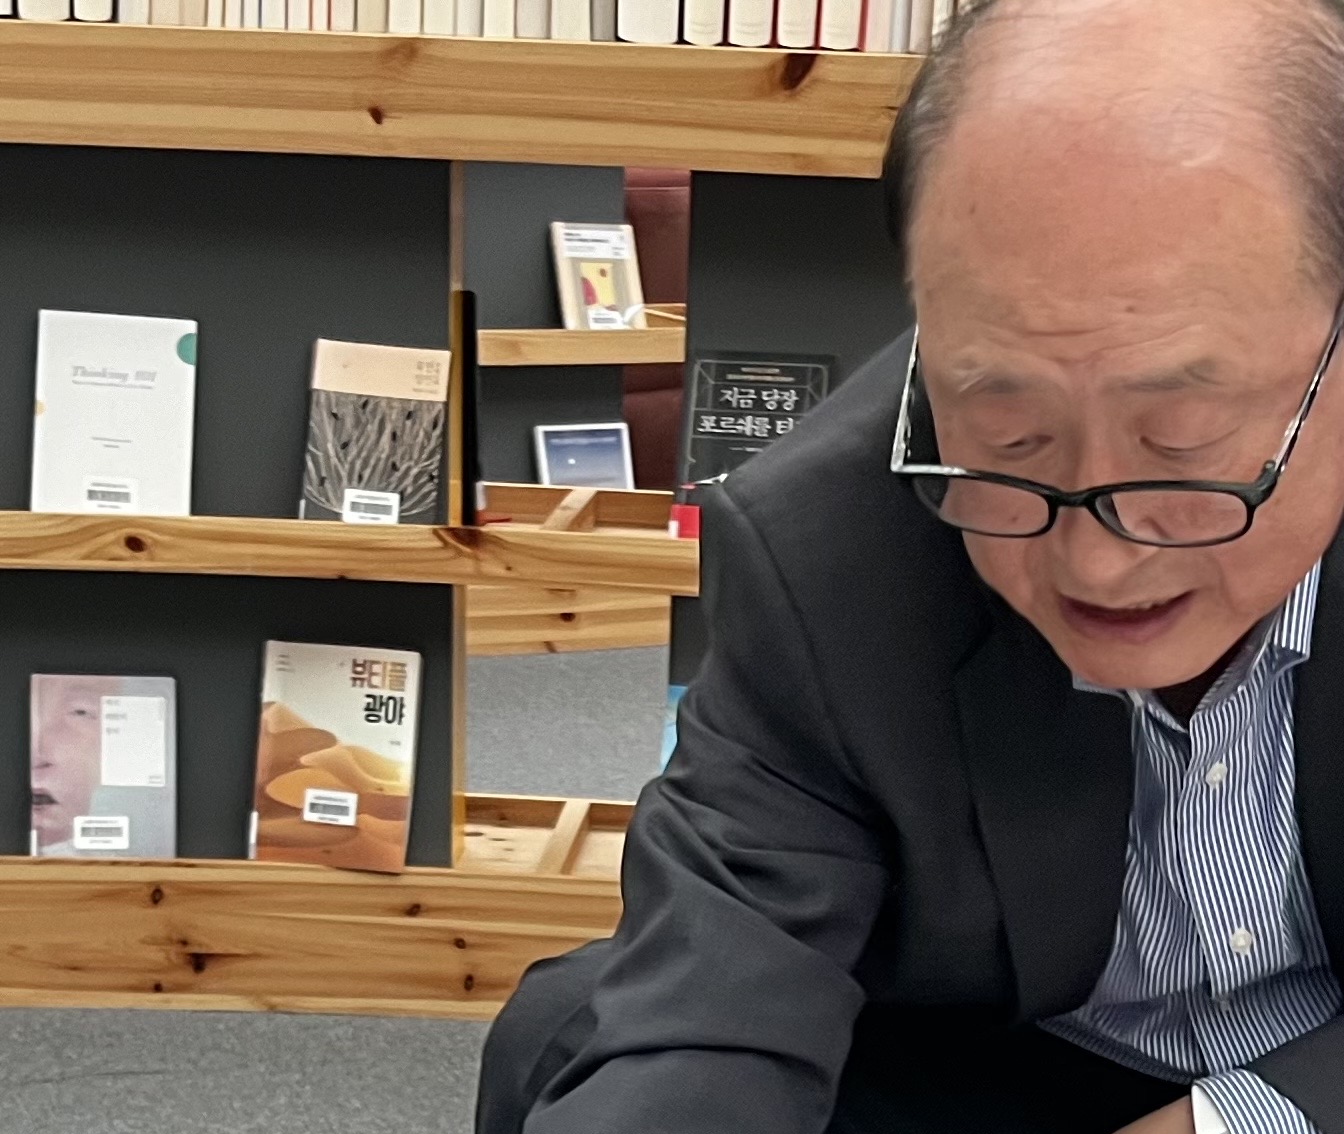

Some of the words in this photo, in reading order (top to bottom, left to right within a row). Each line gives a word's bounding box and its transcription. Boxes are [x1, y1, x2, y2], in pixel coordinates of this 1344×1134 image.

[72, 365, 130, 382] Thinking
[719, 387, 757, 409] 지금
[761, 388, 799, 411] 당장
[697, 415, 772, 438] 포르쉐를
[351, 658, 408, 692] 뷰티풀
[364, 694, 406, 725] 광야
